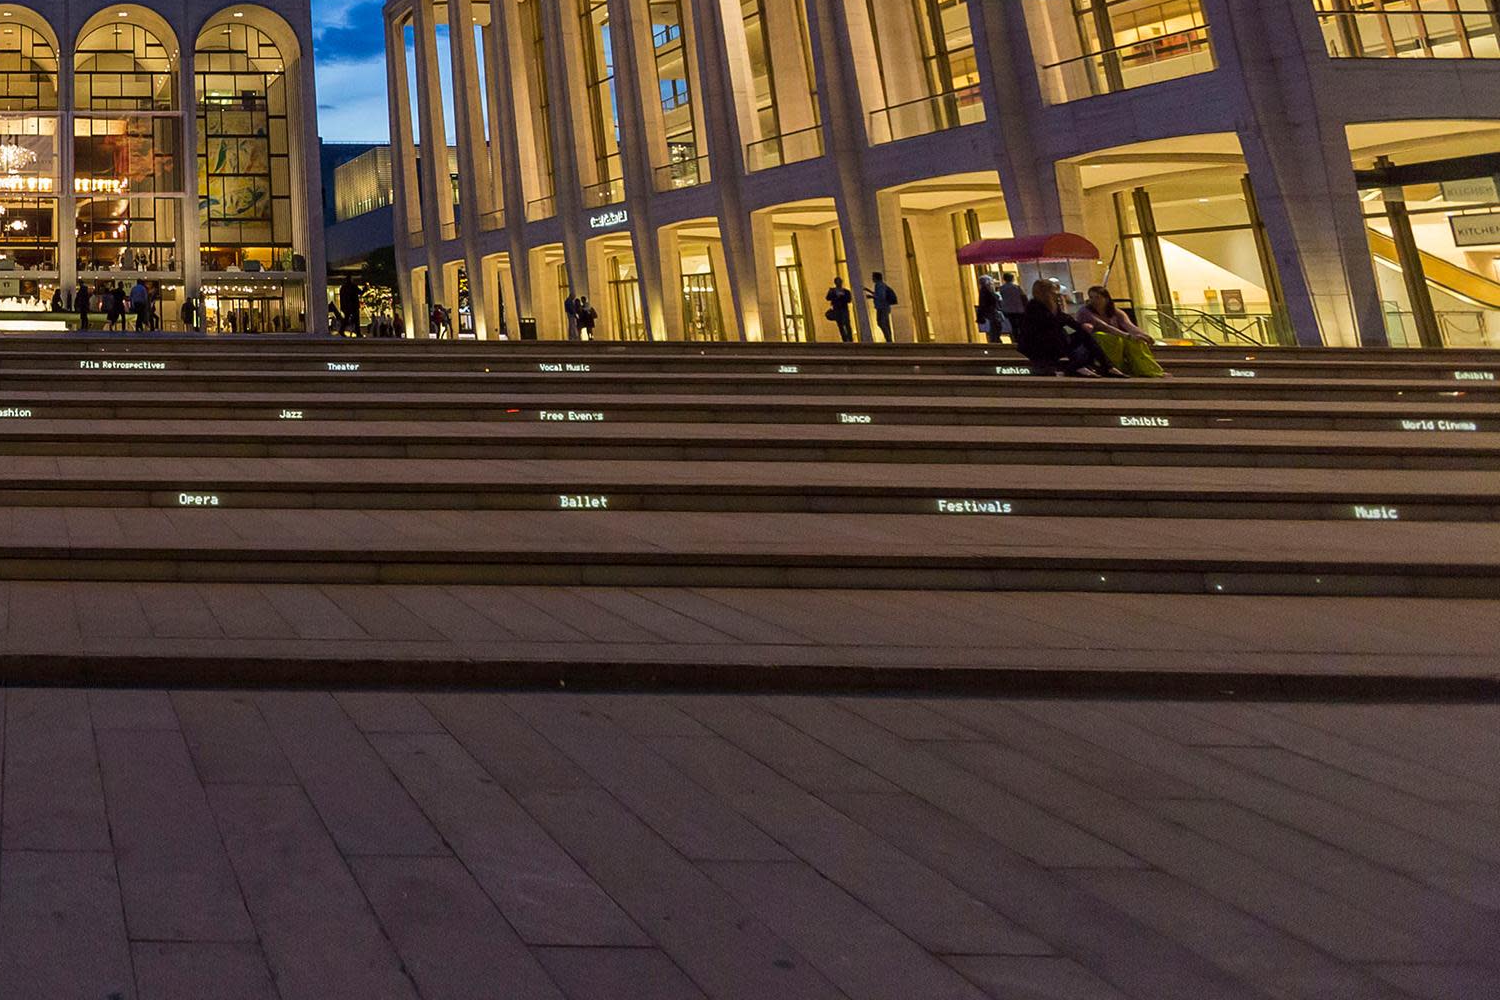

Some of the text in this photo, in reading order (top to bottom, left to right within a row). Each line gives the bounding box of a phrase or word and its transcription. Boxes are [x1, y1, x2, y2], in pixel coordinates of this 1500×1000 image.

[80, 361, 165, 369] Film Retrospectives
[327, 362, 360, 371] Theater
[539, 363, 591, 372] Vocal Music
[995, 366, 1031, 375] Fashion
[279, 409, 303, 419] Jazz
[539, 411, 604, 421] Free Events
[840, 413, 871, 423] Dance
[1119, 416, 1169, 426] Exhibits
[1402, 420, 1435, 430] World
[178, 493, 219, 505] Opera
[559, 495, 608, 508] Ballet
[938, 500, 1012, 513] Festivals
[1353, 505, 1398, 519] Music
